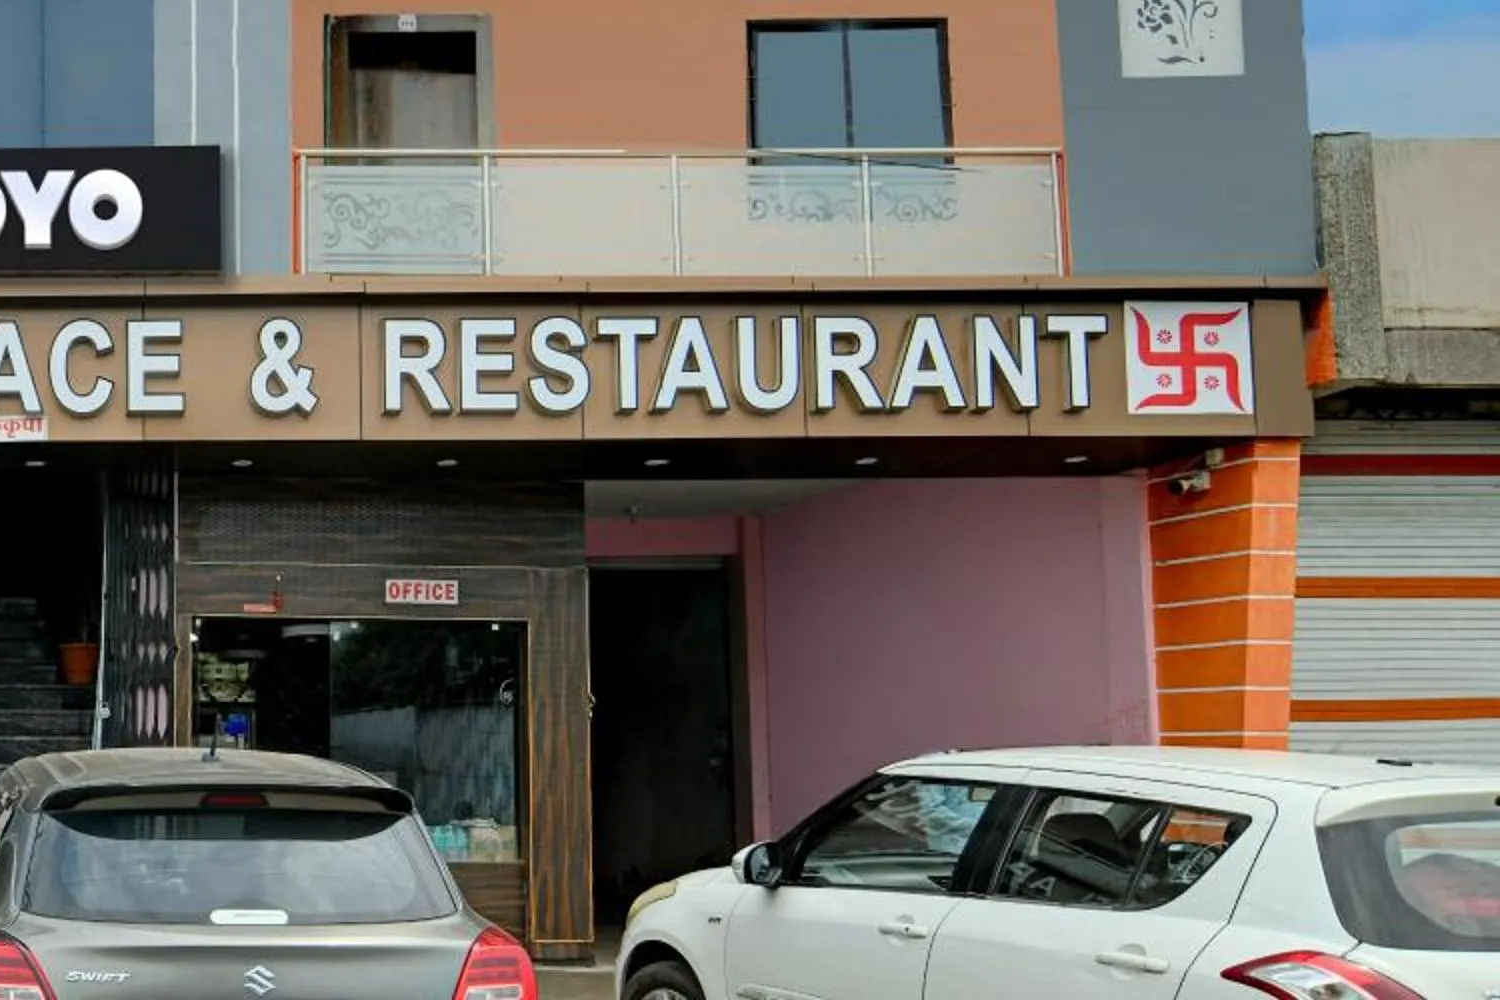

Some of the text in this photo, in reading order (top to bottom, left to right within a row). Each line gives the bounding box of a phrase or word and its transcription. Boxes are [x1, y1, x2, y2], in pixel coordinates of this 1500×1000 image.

[250, 317, 319, 418] &
[382, 314, 1108, 414] RESTAURANT
[388, 582, 455, 600] OFFICE
[65, 970, 132, 983] SWIFT
